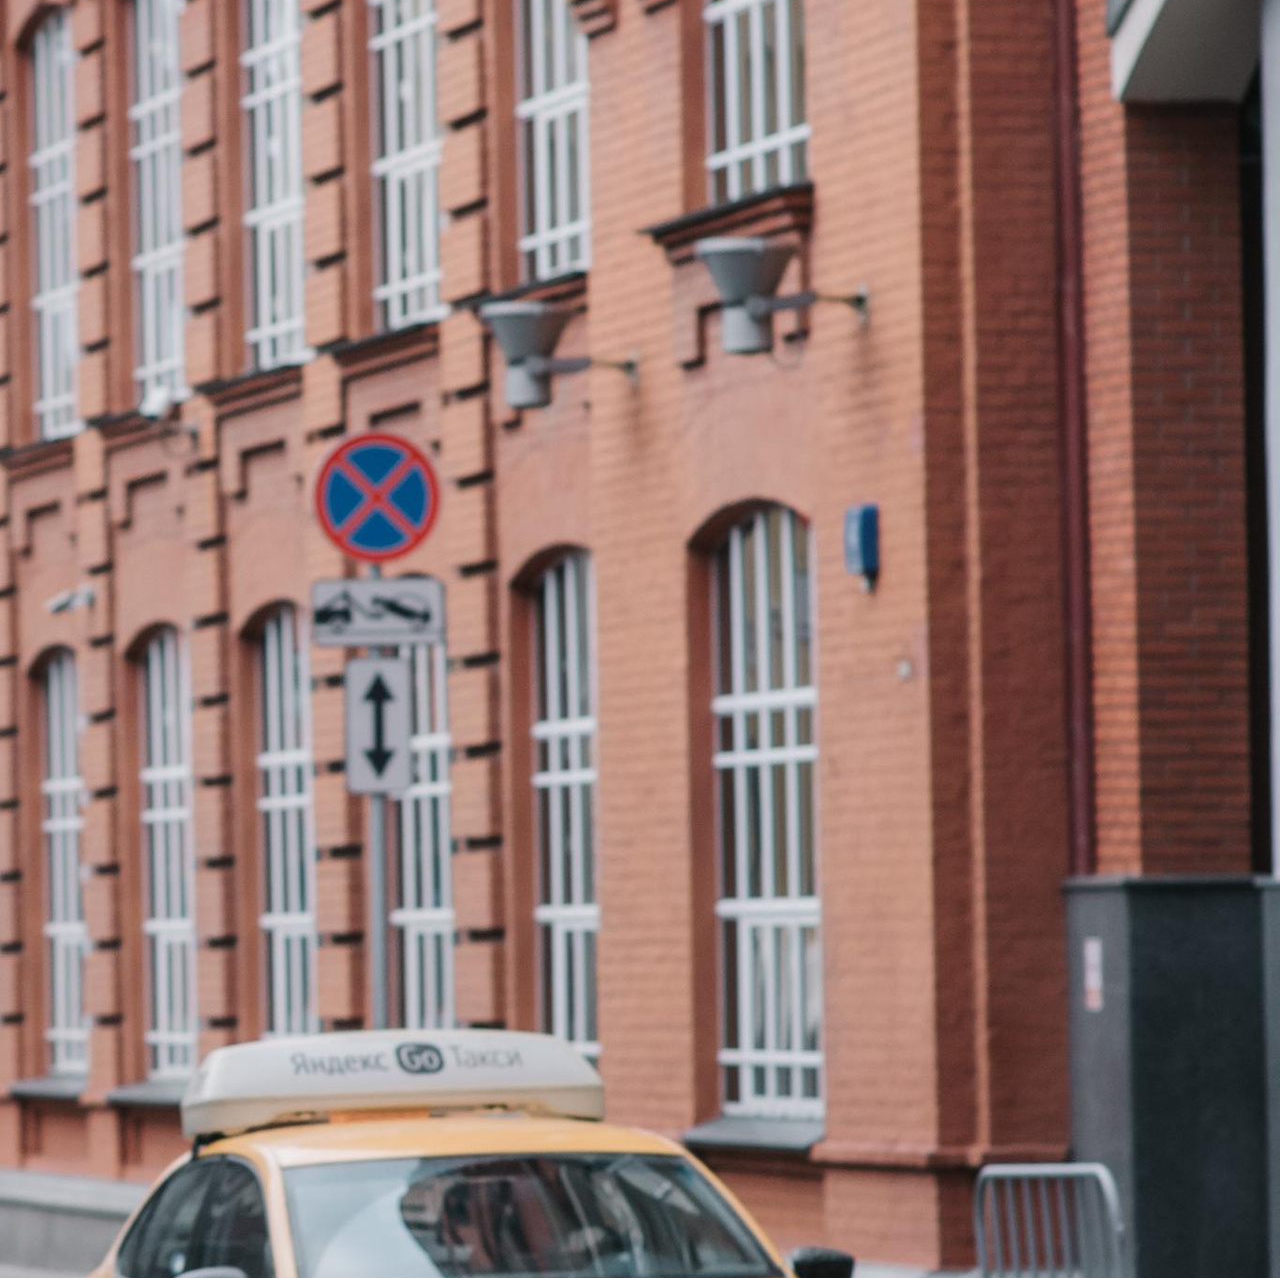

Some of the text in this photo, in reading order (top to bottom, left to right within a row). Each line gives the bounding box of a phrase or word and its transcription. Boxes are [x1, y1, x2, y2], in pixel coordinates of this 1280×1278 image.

[290, 1043, 524, 1076] Яндекс Go Такси
